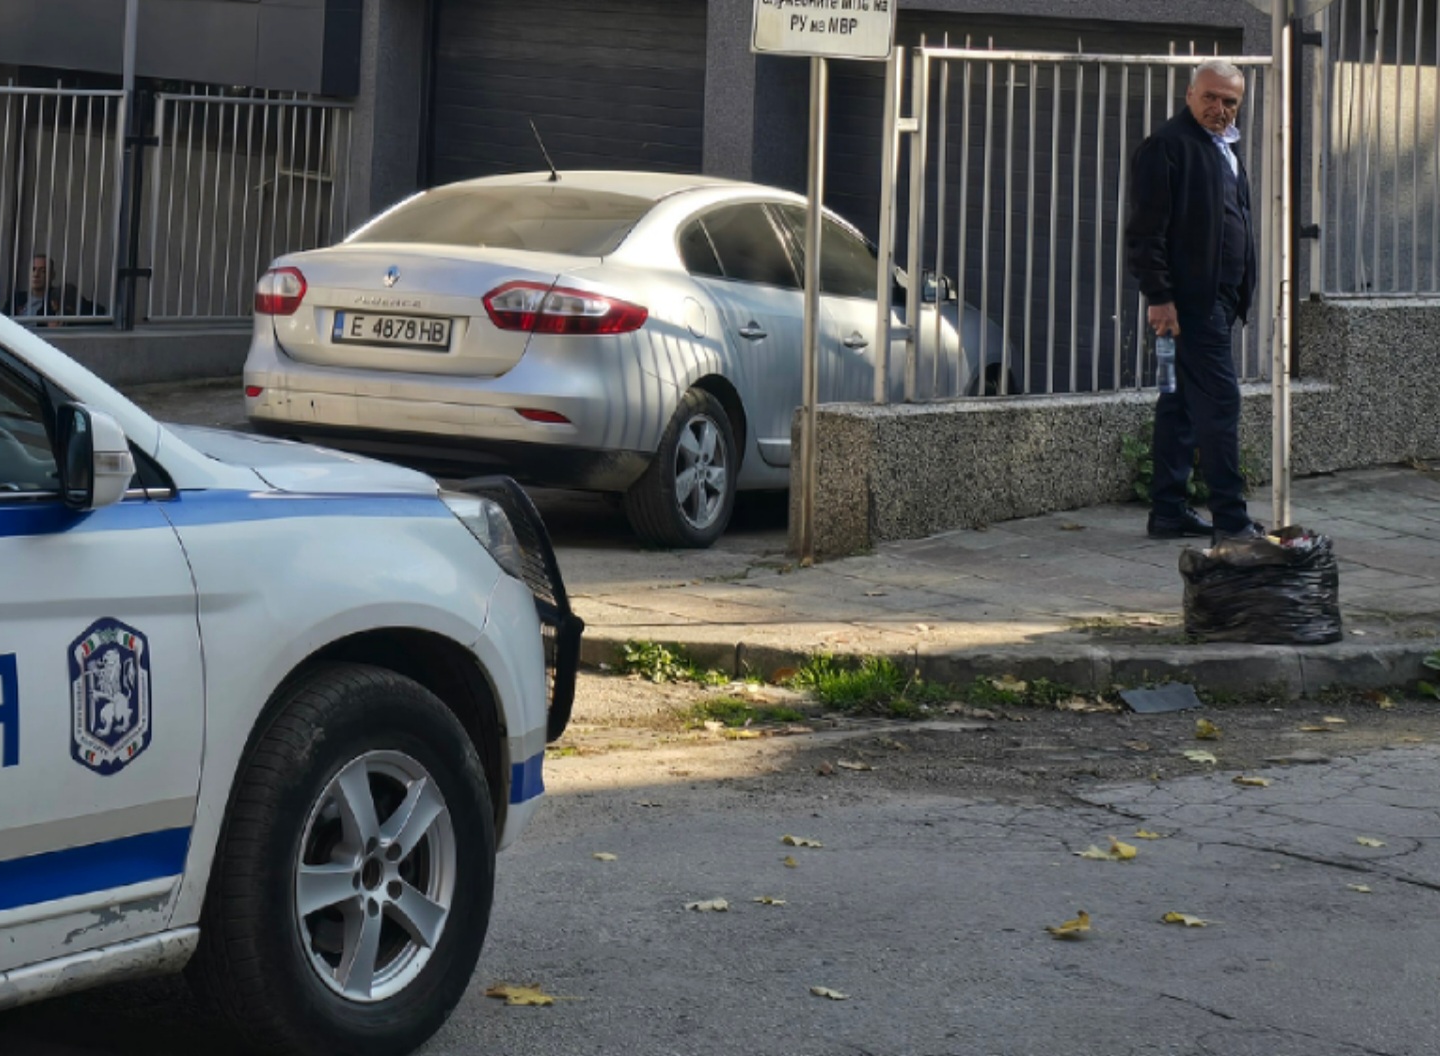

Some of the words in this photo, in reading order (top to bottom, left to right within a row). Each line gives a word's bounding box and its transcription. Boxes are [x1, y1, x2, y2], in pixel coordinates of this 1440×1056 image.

[873, 0, 888, 13] на
[790, 14, 808, 32] РУ
[810, 19, 826, 33] на
[828, 17, 858, 36] МВР
[350, 315, 365, 337] E
[373, 316, 417, 340] 4878
